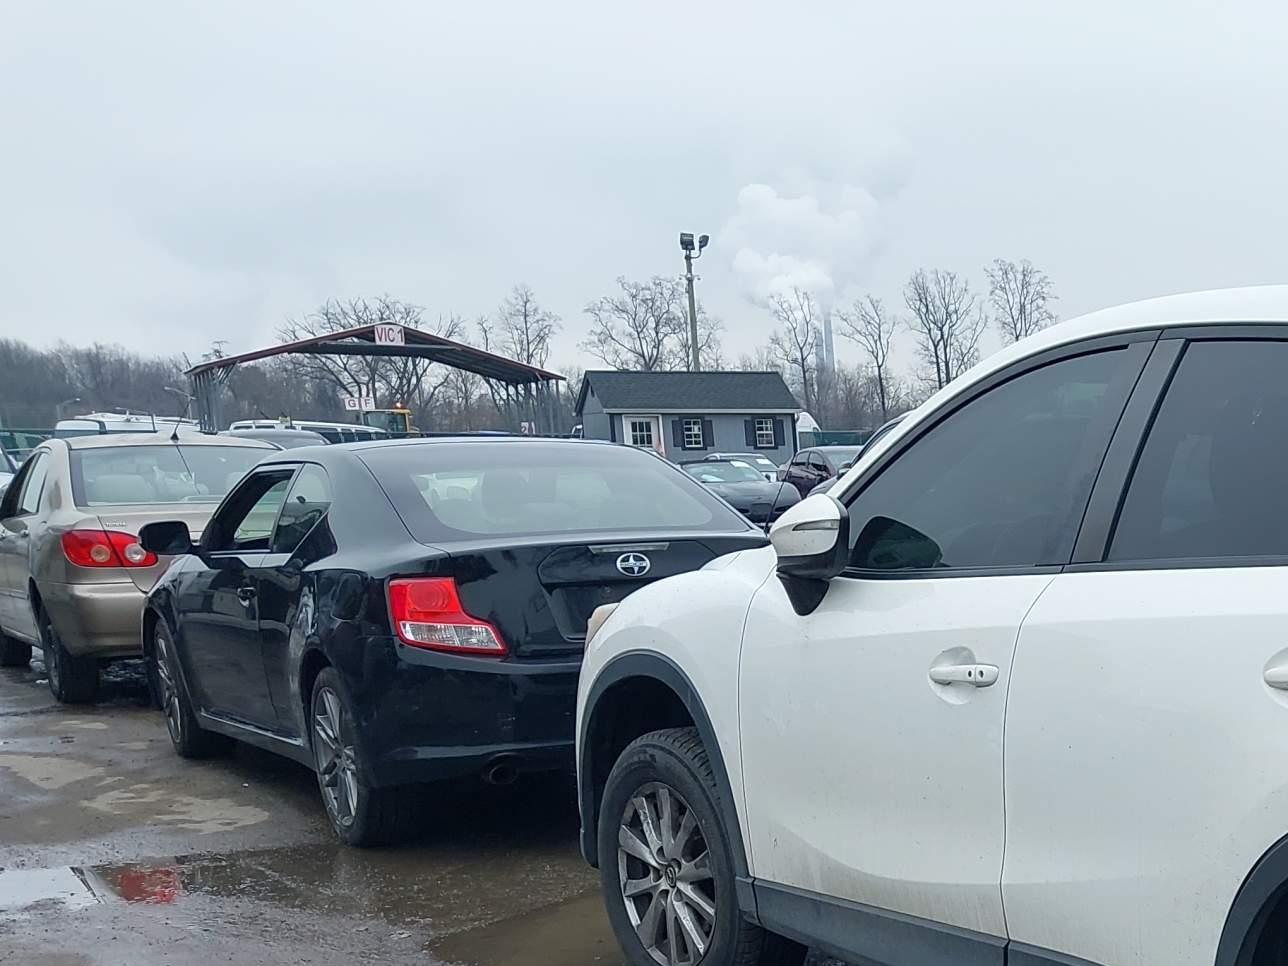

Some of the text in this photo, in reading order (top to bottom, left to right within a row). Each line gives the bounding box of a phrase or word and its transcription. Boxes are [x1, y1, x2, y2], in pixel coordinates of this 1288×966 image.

[376, 327, 404, 343] VIC 1
[348, 399, 356, 408] G
